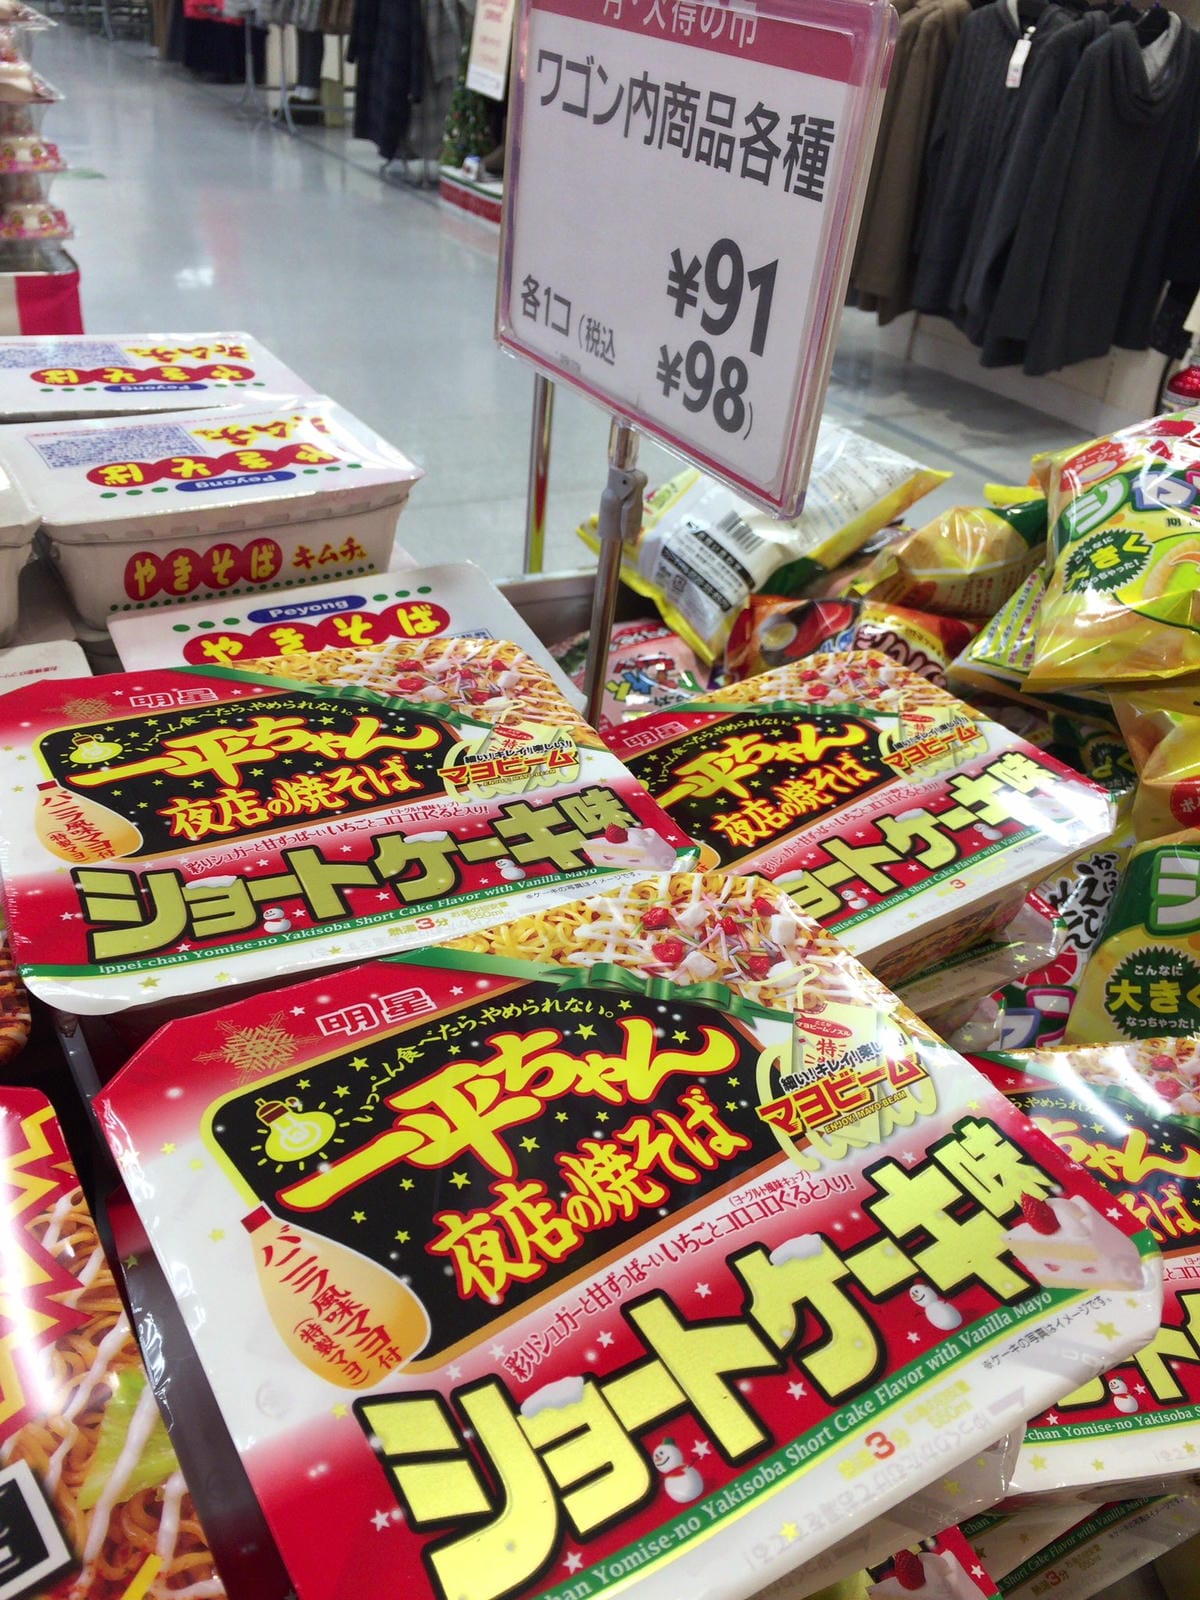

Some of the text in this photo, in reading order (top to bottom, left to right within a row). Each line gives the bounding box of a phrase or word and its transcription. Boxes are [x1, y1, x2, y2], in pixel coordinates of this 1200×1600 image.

[537, 49, 835, 202] ワゴン内商品各種
[521, 274, 571, 337] 各1コ
[578, 314, 615, 366] (税込
[667, 238, 779, 356] ¥91
[196, 474, 276, 489] Peyong
[134, 535, 368, 597] やきそば キムチ
[201, 603, 442, 661] やきそば
[269, 600, 350, 619] Peyong
[130, 687, 219, 709] 明星
[68, 715, 443, 787] 一平ちゃん
[437, 749, 580, 785] マヨビーム
[623, 721, 688, 749] 明星
[656, 722, 868, 809] 一平ちゃん
[880, 725, 984, 770] マヨビーム
[158, 754, 424, 841] 夜店の焼そば
[709, 751, 881, 849] 夜店の焼そば
[72, 786, 641, 962] ショートケーキ味
[868, 892, 910, 918] Yakisoba
[908, 878, 934, 895] Short
[933, 868, 955, 883] Cake
[955, 853, 982, 875] Flavor
[982, 843, 1002, 858] with
[100, 953, 188, 975] Ippei-chan
[193, 936, 278, 958] Yomise-no
[282, 918, 352, 942] Yakisoba
[355, 911, 395, 927] Short
[399, 903, 435, 917] Cake
[437, 892, 482, 908] Flavor
[484, 883, 514, 897] with
[518, 873, 561, 889] Vanilla
[565, 866, 598, 880] Mayo
[1134, 965, 1184, 976] こんなに
[315, 987, 438, 1037] 明星
[1126, 1016, 1195, 1029] なっちゃった!
[352, 997, 615, 1124] いっぺん食べたら、やめられない。
[754, 1051, 930, 1137] マヨビーム
[276, 1016, 739, 1211] 一平ちゃん
[824, 1114, 857, 1135] ENJOY!
[426, 1087, 753, 1305] 夜店の焼そば
[261, 1223, 403, 1370] バニラ風味マヨ付
[293, 1320, 371, 1387] (特製マヨ)
[354, 1115, 1061, 1600] ショートケーキ味
[592, 1515, 702, 1587] Yomise-no
[700, 1456, 787, 1521] Yakisoba
[785, 1426, 835, 1467] Short
[833, 1401, 876, 1433] Cake
[875, 1366, 926, 1407] Flavor
[926, 1345, 962, 1378] with
[959, 1314, 1014, 1357] Vanilla
[1014, 1291, 1053, 1320] Mayo
[1061, 1419, 1134, 1437] Yomise-no
[1134, 1410, 1194, 1426] Yakisoba
[1028, 1552, 1050, 1572] Cake
[1049, 1530, 1077, 1558] Flavor
[1077, 1519, 1097, 1538] with
[1096, 1504, 1127, 1530] Vanilla
